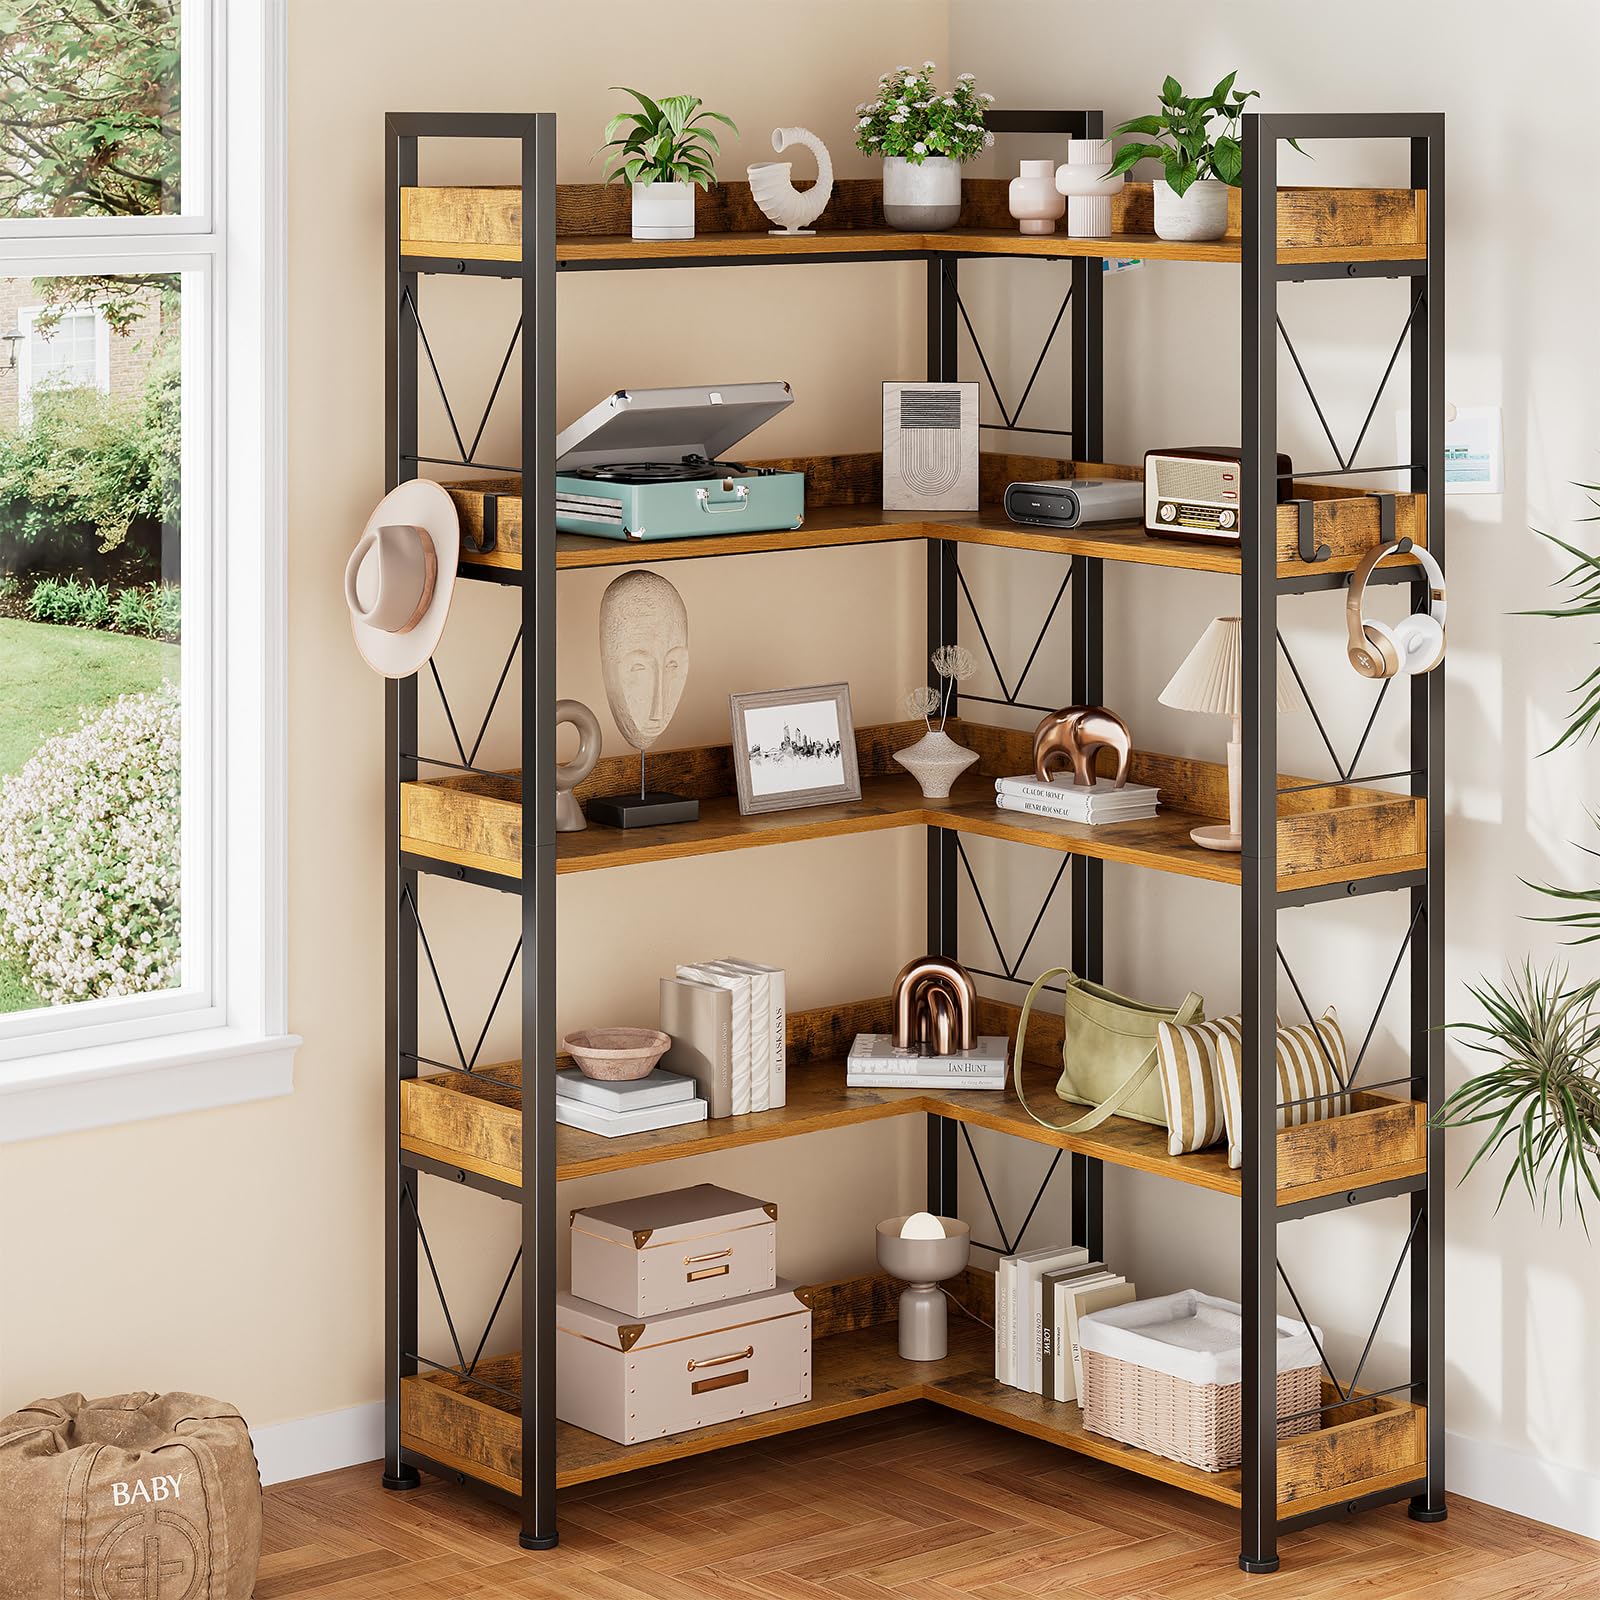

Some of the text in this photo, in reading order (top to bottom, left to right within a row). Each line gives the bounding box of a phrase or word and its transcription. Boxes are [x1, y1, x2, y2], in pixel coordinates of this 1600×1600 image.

[1022, 787, 1065, 800] CLAUDE MONET
[1024, 802, 1070, 816] HENRI ROUSSEAU
[775, 1007, 783, 1063] LASKASAS
[948, 1063, 963, 1072] IAN
[964, 1063, 987, 1073] HUNT
[1043, 1327, 1051, 1356] LOEWE
[111, 1473, 183, 1506] BABY
